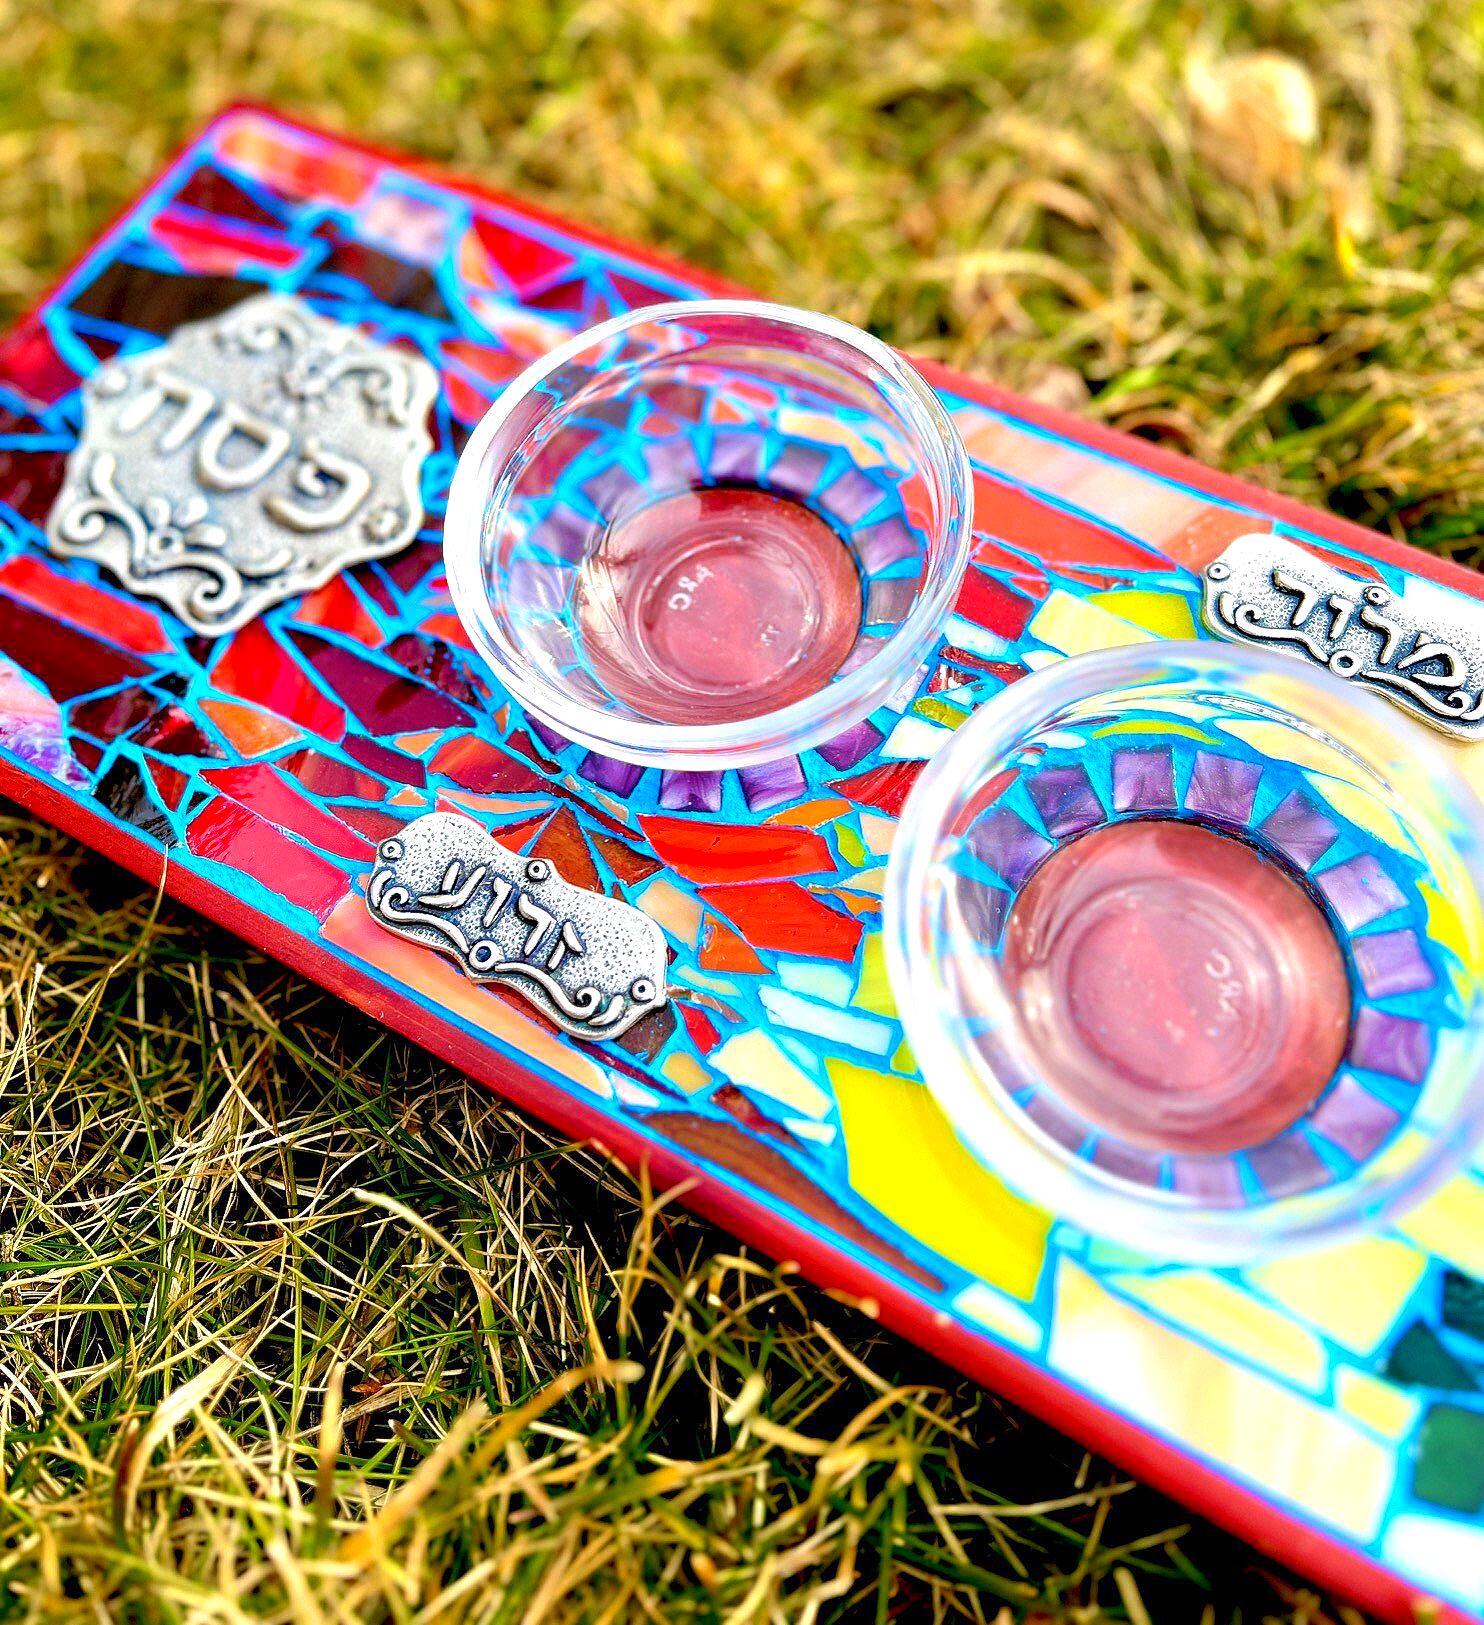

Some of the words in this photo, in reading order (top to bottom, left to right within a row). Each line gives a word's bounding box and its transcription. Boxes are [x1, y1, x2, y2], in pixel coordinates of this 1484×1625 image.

[117, 370, 371, 533] פסח
[1271, 567, 1467, 687] מרור
[418, 861, 585, 972] זרוע
